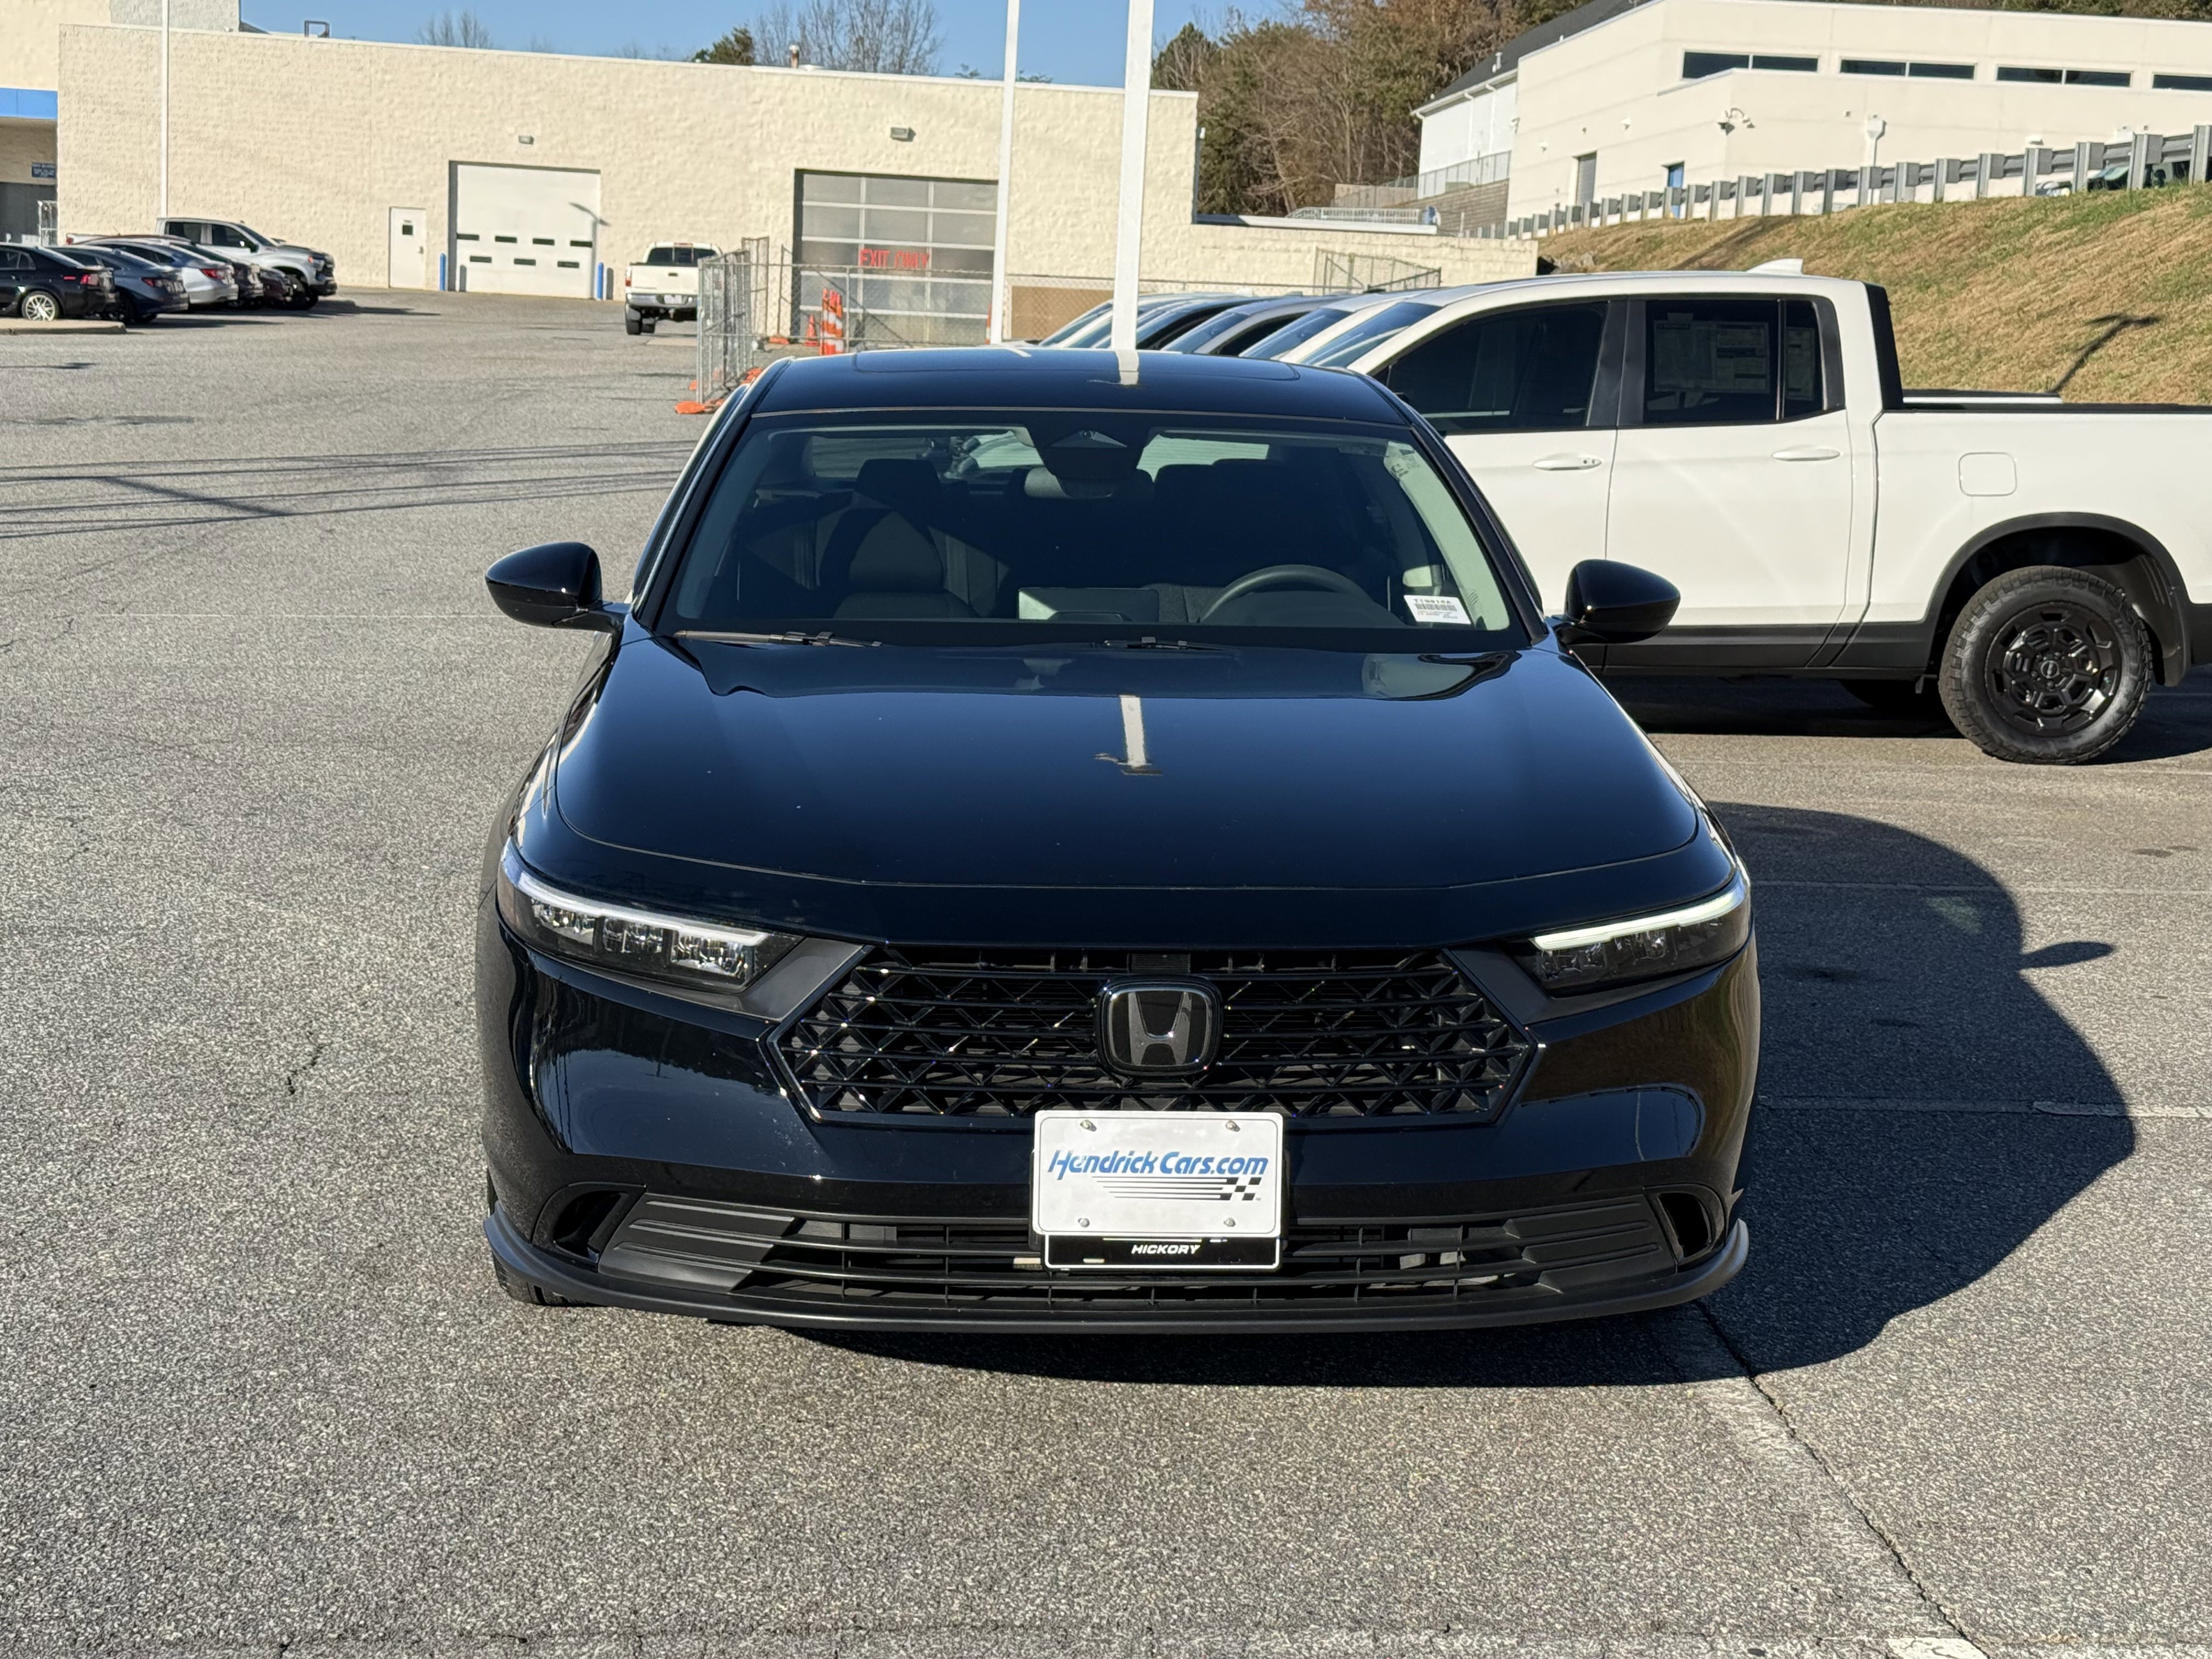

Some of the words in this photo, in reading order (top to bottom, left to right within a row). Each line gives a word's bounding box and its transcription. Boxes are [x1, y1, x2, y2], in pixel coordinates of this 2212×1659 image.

[860, 248, 890, 268] EXIT
[894, 250, 930, 269] ONLY
[1131, 1244, 1201, 1255] HICKORY
